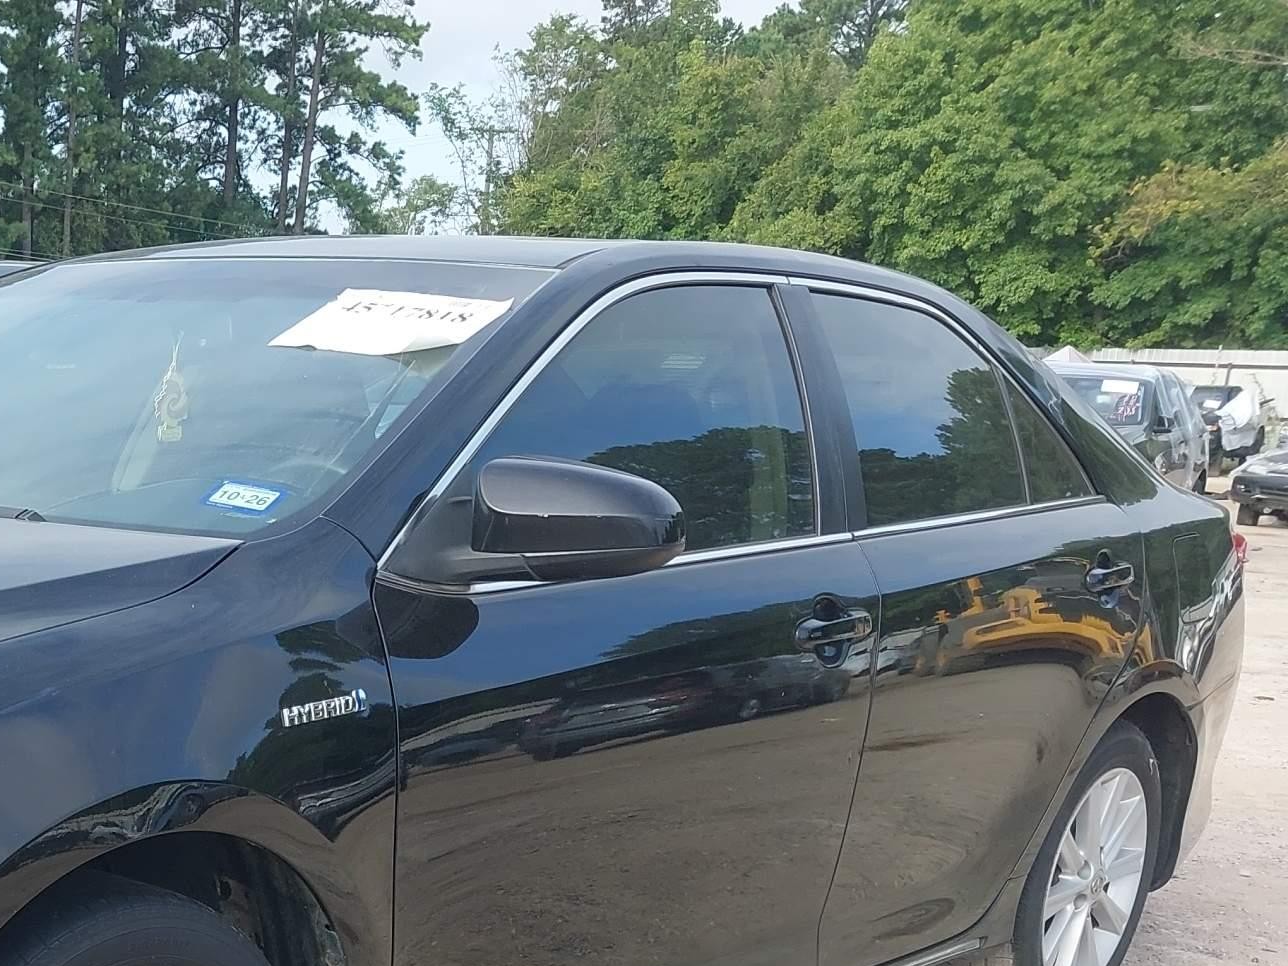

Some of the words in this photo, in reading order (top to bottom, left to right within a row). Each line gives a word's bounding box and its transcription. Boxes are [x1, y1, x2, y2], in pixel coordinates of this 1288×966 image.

[218, 490, 240, 501] 10
[244, 494, 270, 506] 26
[281, 695, 354, 727] HYBRID
